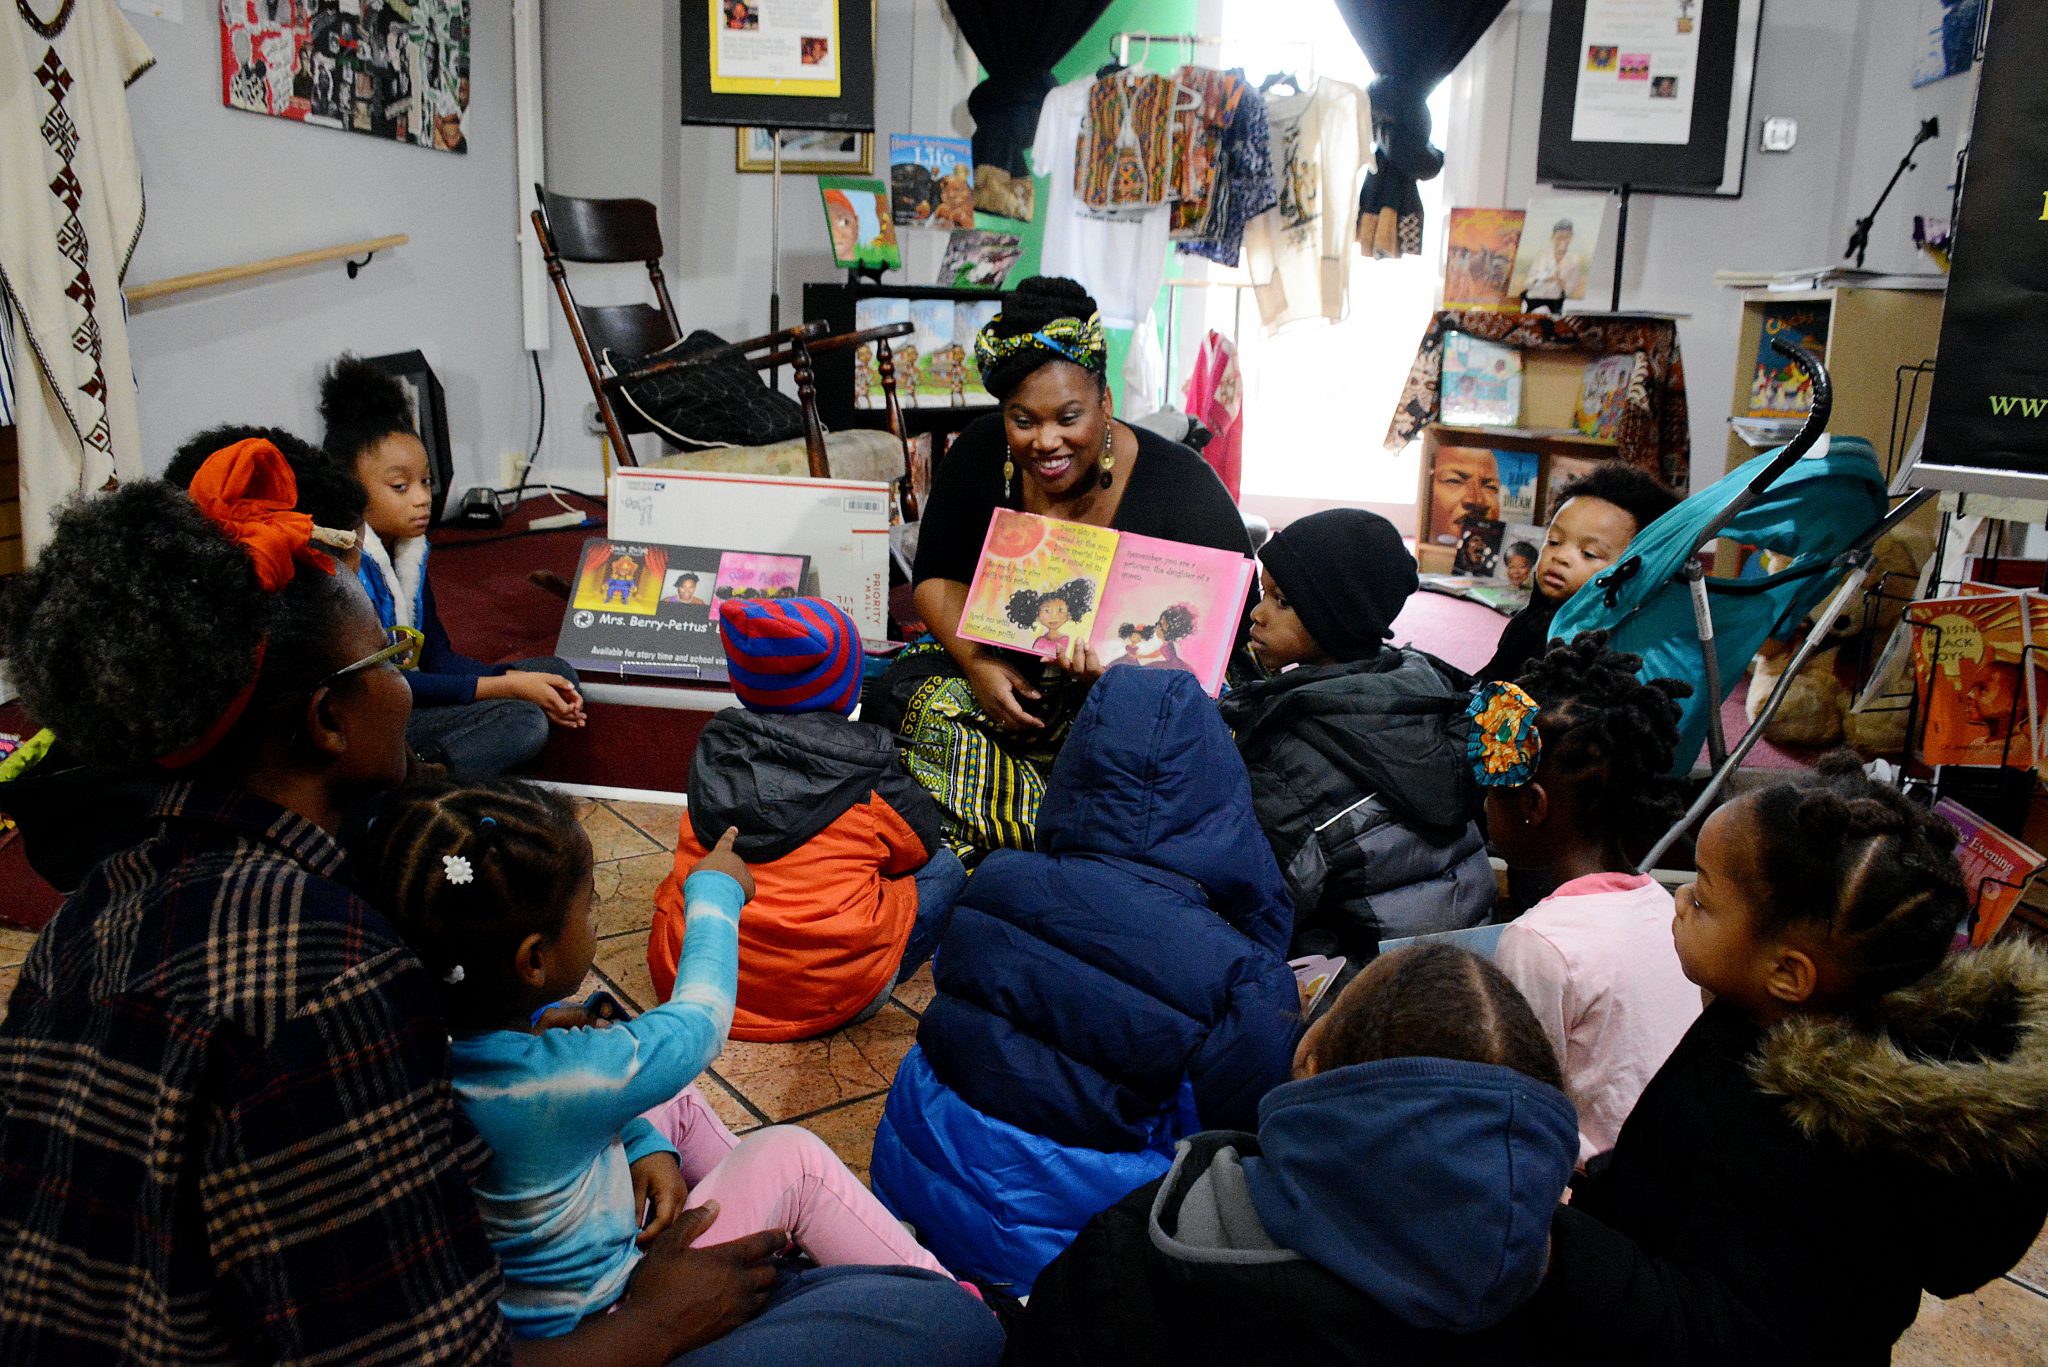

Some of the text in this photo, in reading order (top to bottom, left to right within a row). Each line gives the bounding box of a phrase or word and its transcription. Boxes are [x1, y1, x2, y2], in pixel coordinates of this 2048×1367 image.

[1988, 395, 2048, 418] ww
[1166, 568, 1196, 580] daughter
[873, 573, 881, 626] PRIORITY
[599, 613, 626, 627] Mrs.
[629, 615, 712, 634] Berry-Pettus'
[591, 645, 624, 658] Available
[624, 648, 636, 658] for
[636, 650, 656, 661] story
[657, 652, 674, 662] time
[674, 653, 689, 663] and
[690, 654, 714, 665] school
[1968, 837, 2016, 876] Evening
